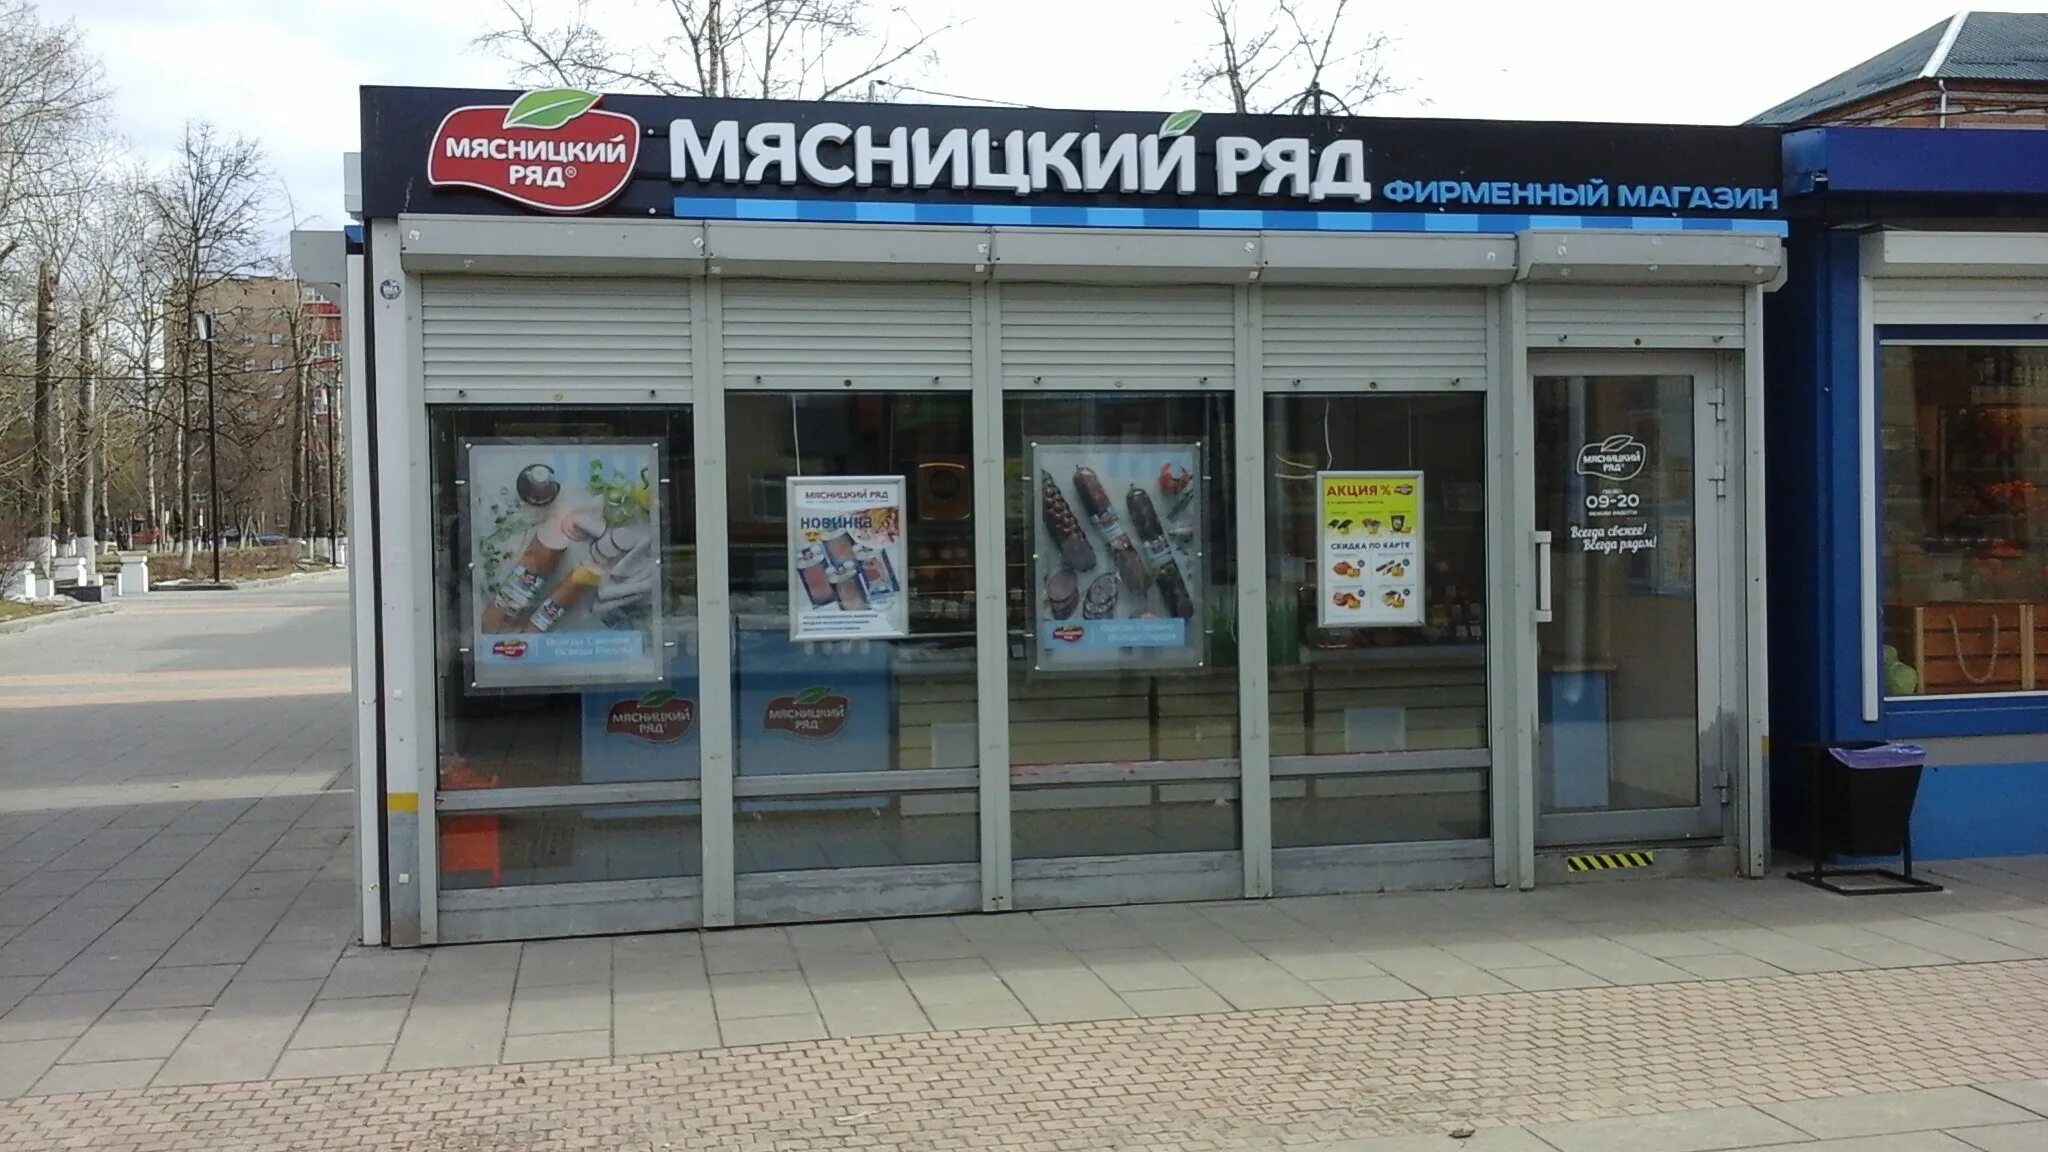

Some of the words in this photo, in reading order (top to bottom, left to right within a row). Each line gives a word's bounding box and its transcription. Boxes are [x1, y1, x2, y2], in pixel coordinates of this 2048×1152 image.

[445, 134, 627, 163] МЯСНИЦКИЙ
[669, 113, 1197, 196] МЯСНИЦКИЙ
[1216, 136, 1372, 202] РЯД
[1382, 178, 1609, 206] ФИРМЕННЫЙ
[1617, 185, 1779, 210] МАГАЗИН
[869, 490, 889, 499] РЯД
[1327, 484, 1378, 498] АКЦИЯ
[1585, 493, 1640, 509] 09-20
[1570, 525, 1605, 542] Всегда
[1330, 542, 1367, 550] СКИДКА
[1369, 542, 1381, 550] ПО
[1382, 541, 1411, 549] КАРТЕ
[1583, 538, 1618, 554] Всегда
[612, 707, 691, 723] МЯСНИЦКИЙ
[768, 704, 845, 720] МЯСНИЦКИЙ
